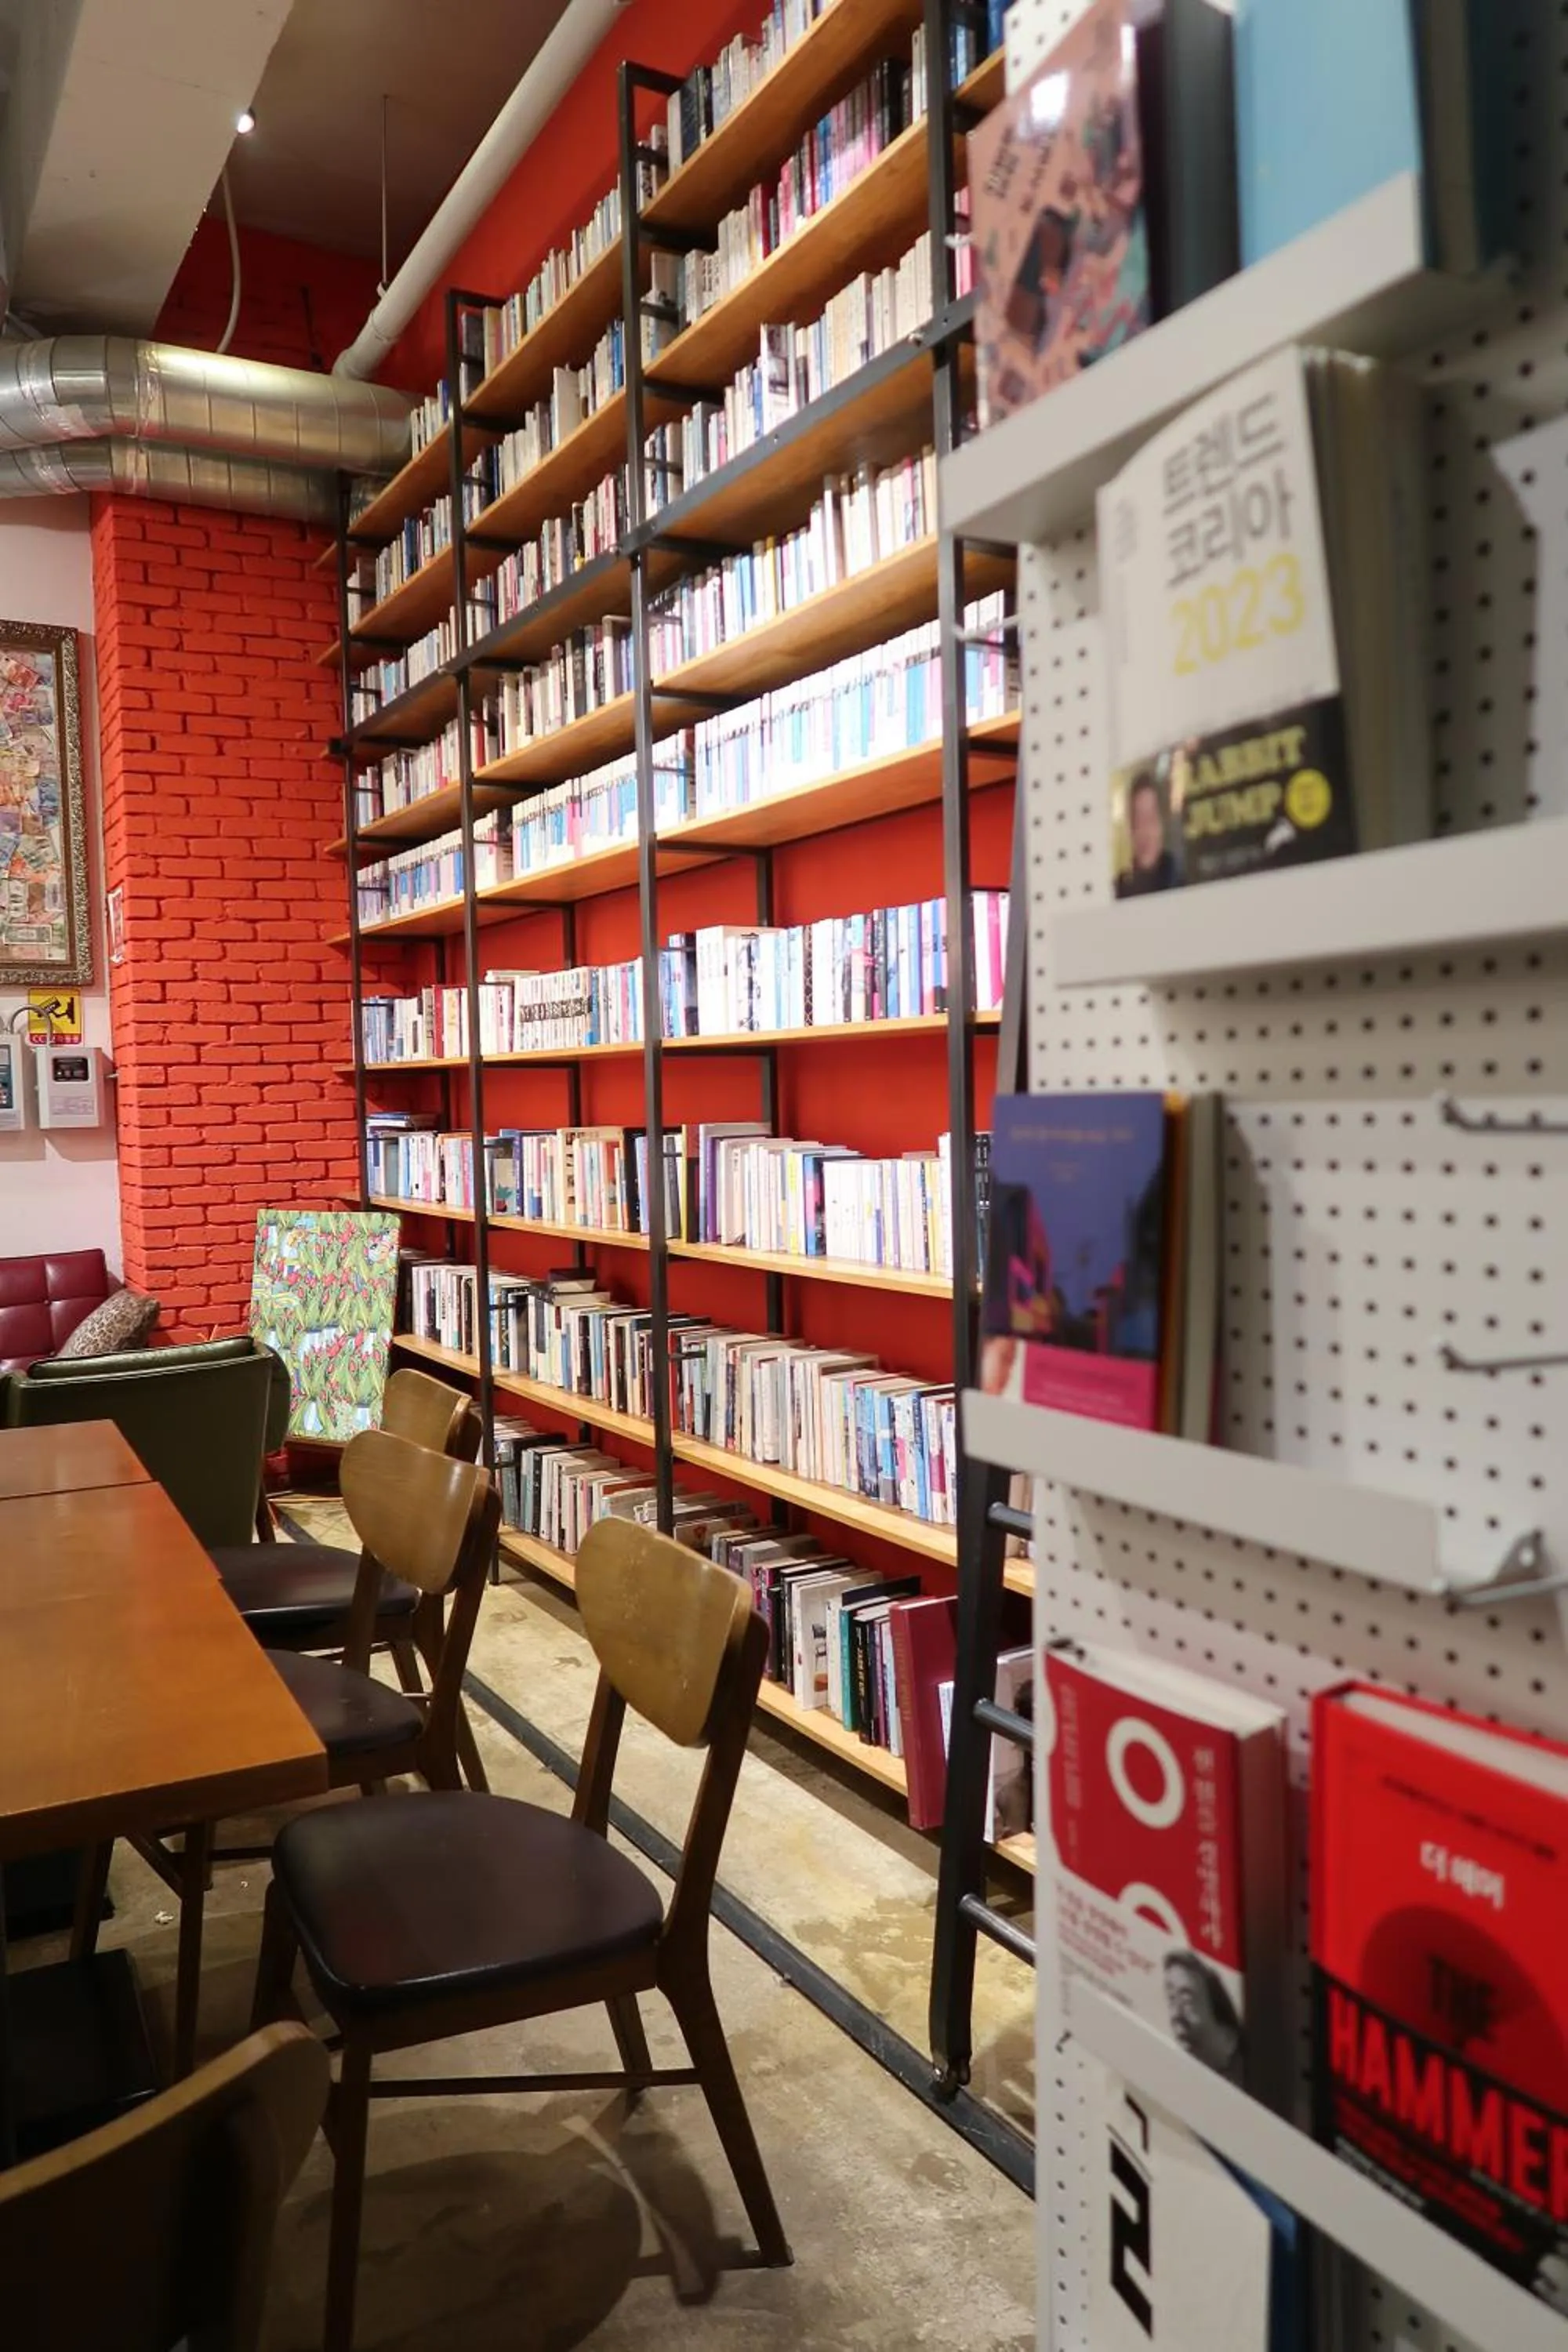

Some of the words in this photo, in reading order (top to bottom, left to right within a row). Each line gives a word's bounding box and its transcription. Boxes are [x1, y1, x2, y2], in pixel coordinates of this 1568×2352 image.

[1163, 391, 1287, 516] 트렌드
[1166, 468, 1295, 589] 코리아
[1170, 552, 1305, 676] 2023
[1185, 781, 1283, 839] JUMP
